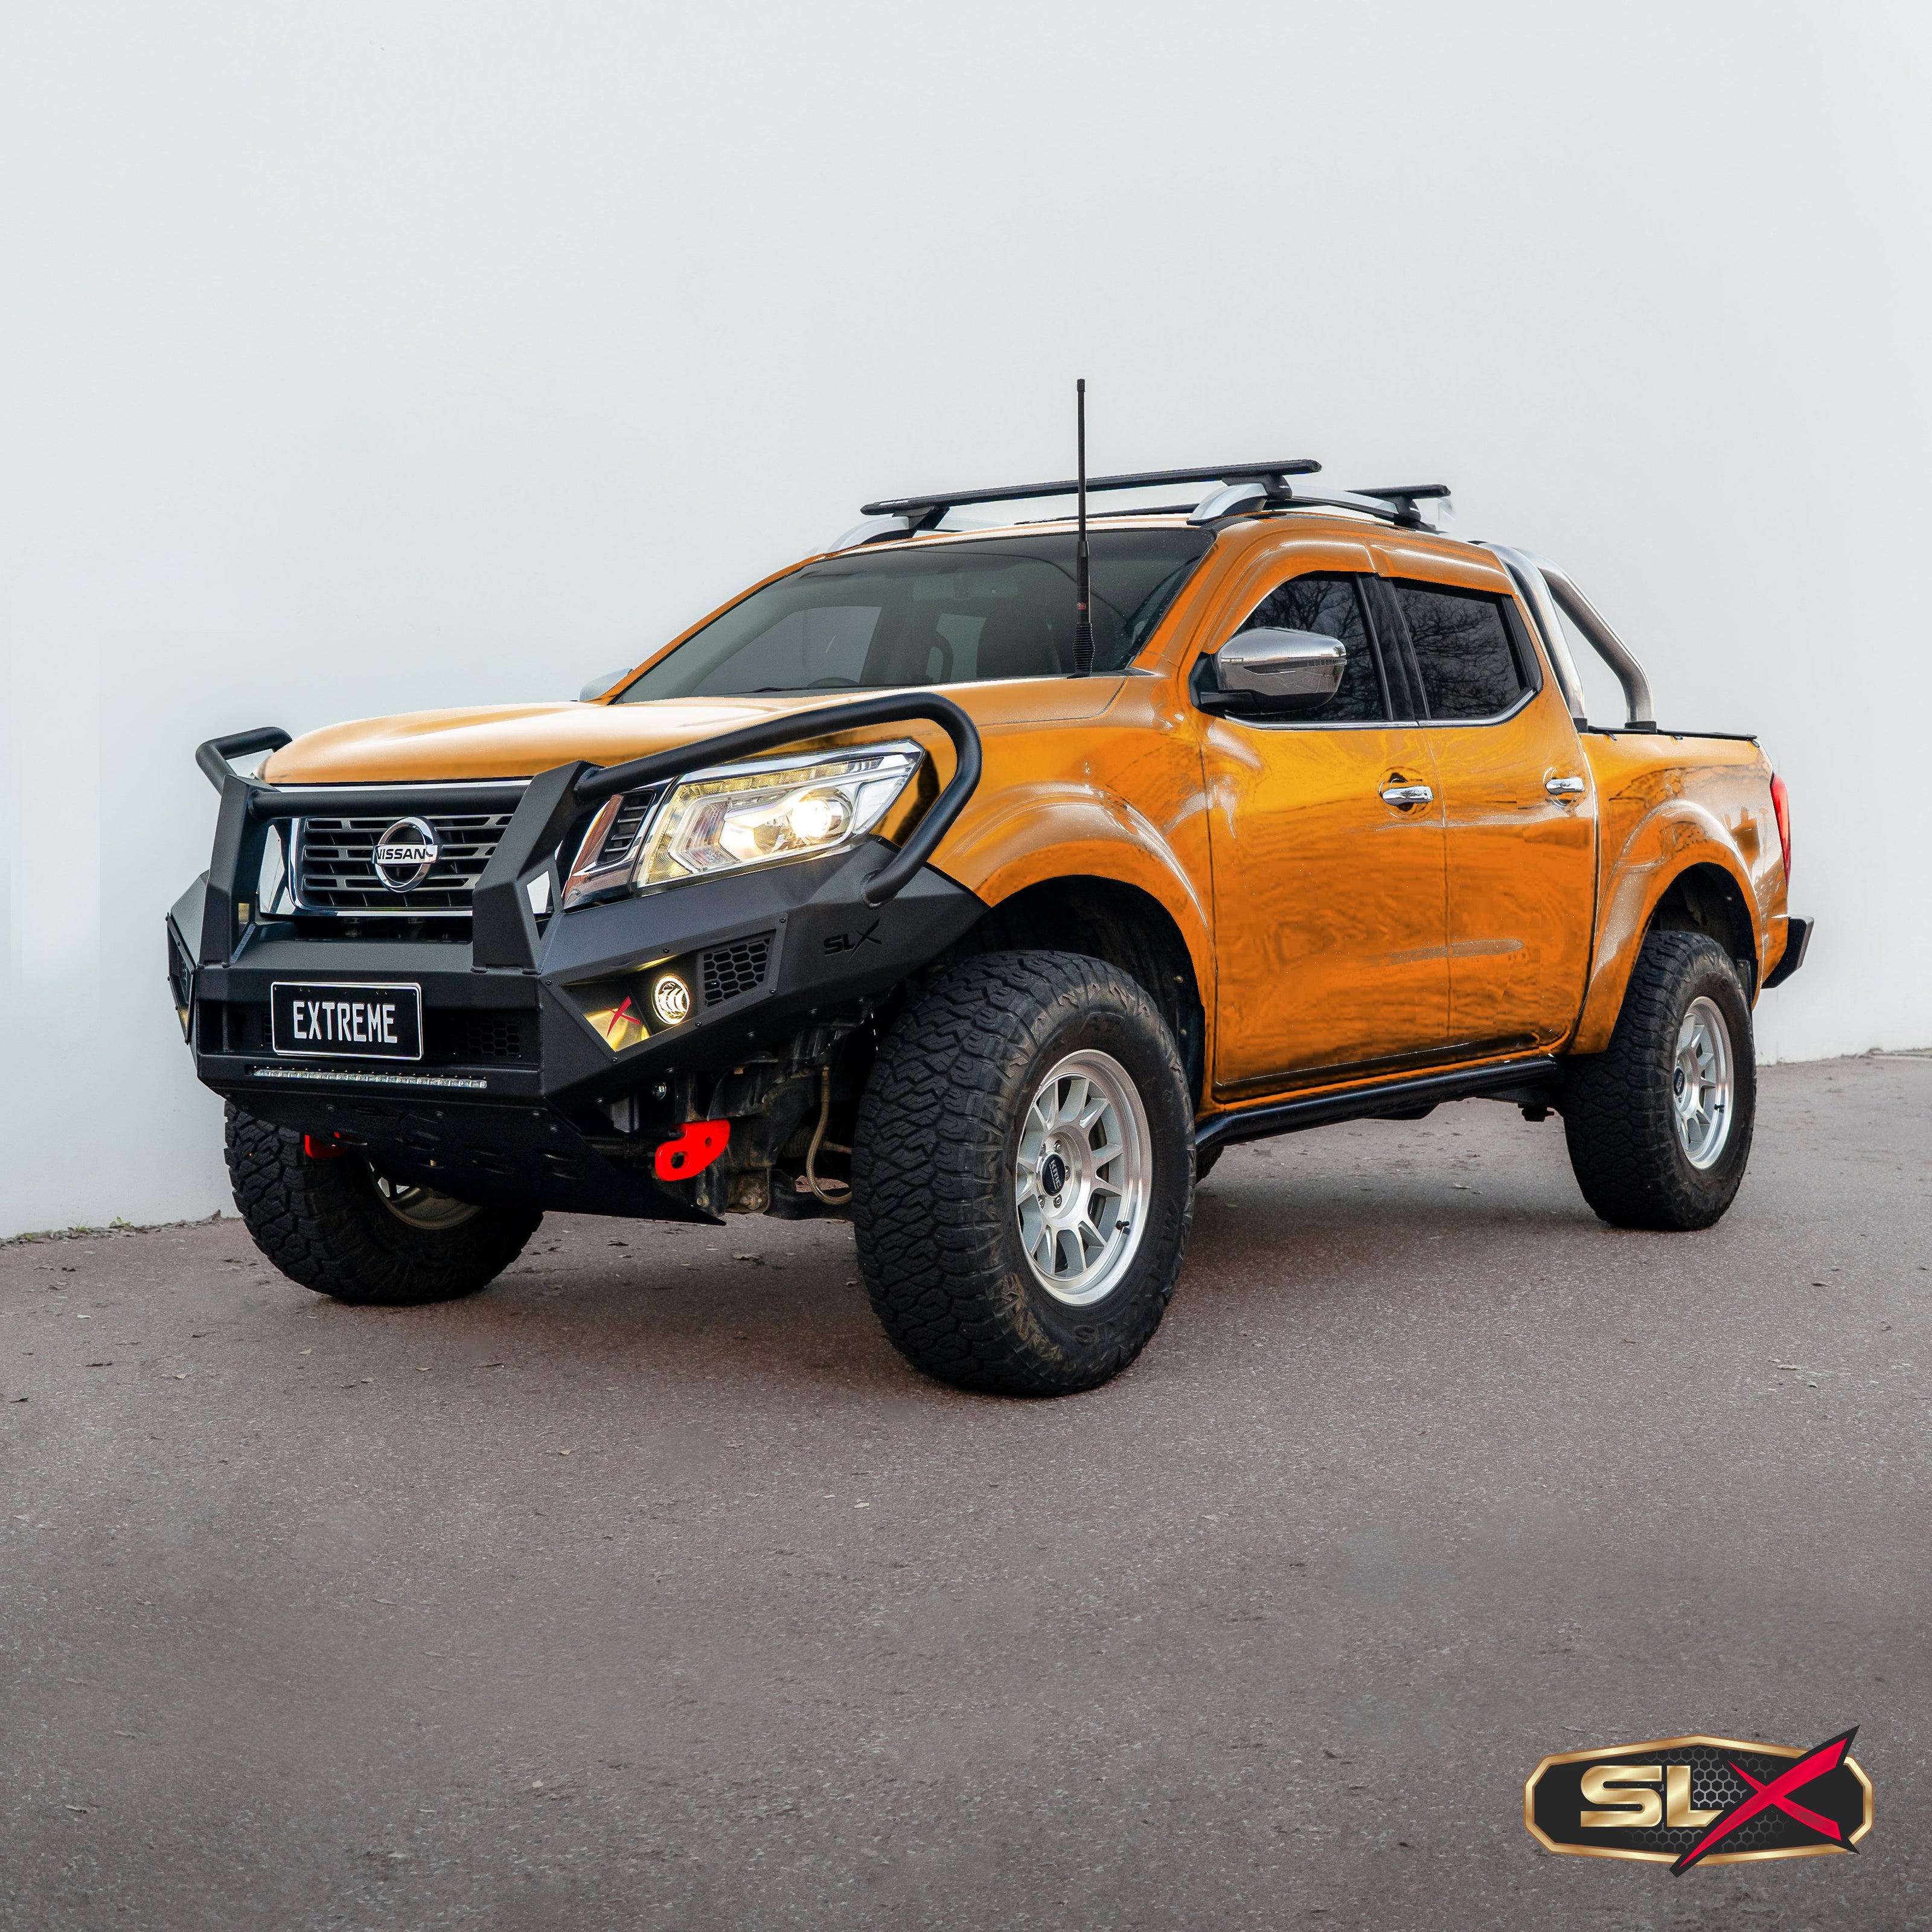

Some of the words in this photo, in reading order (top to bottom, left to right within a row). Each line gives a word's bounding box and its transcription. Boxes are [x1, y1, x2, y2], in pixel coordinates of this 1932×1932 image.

[376, 847, 426, 860] NISSAN
[824, 918, 882, 962] SLX
[293, 1000, 398, 1043] EXTREME
